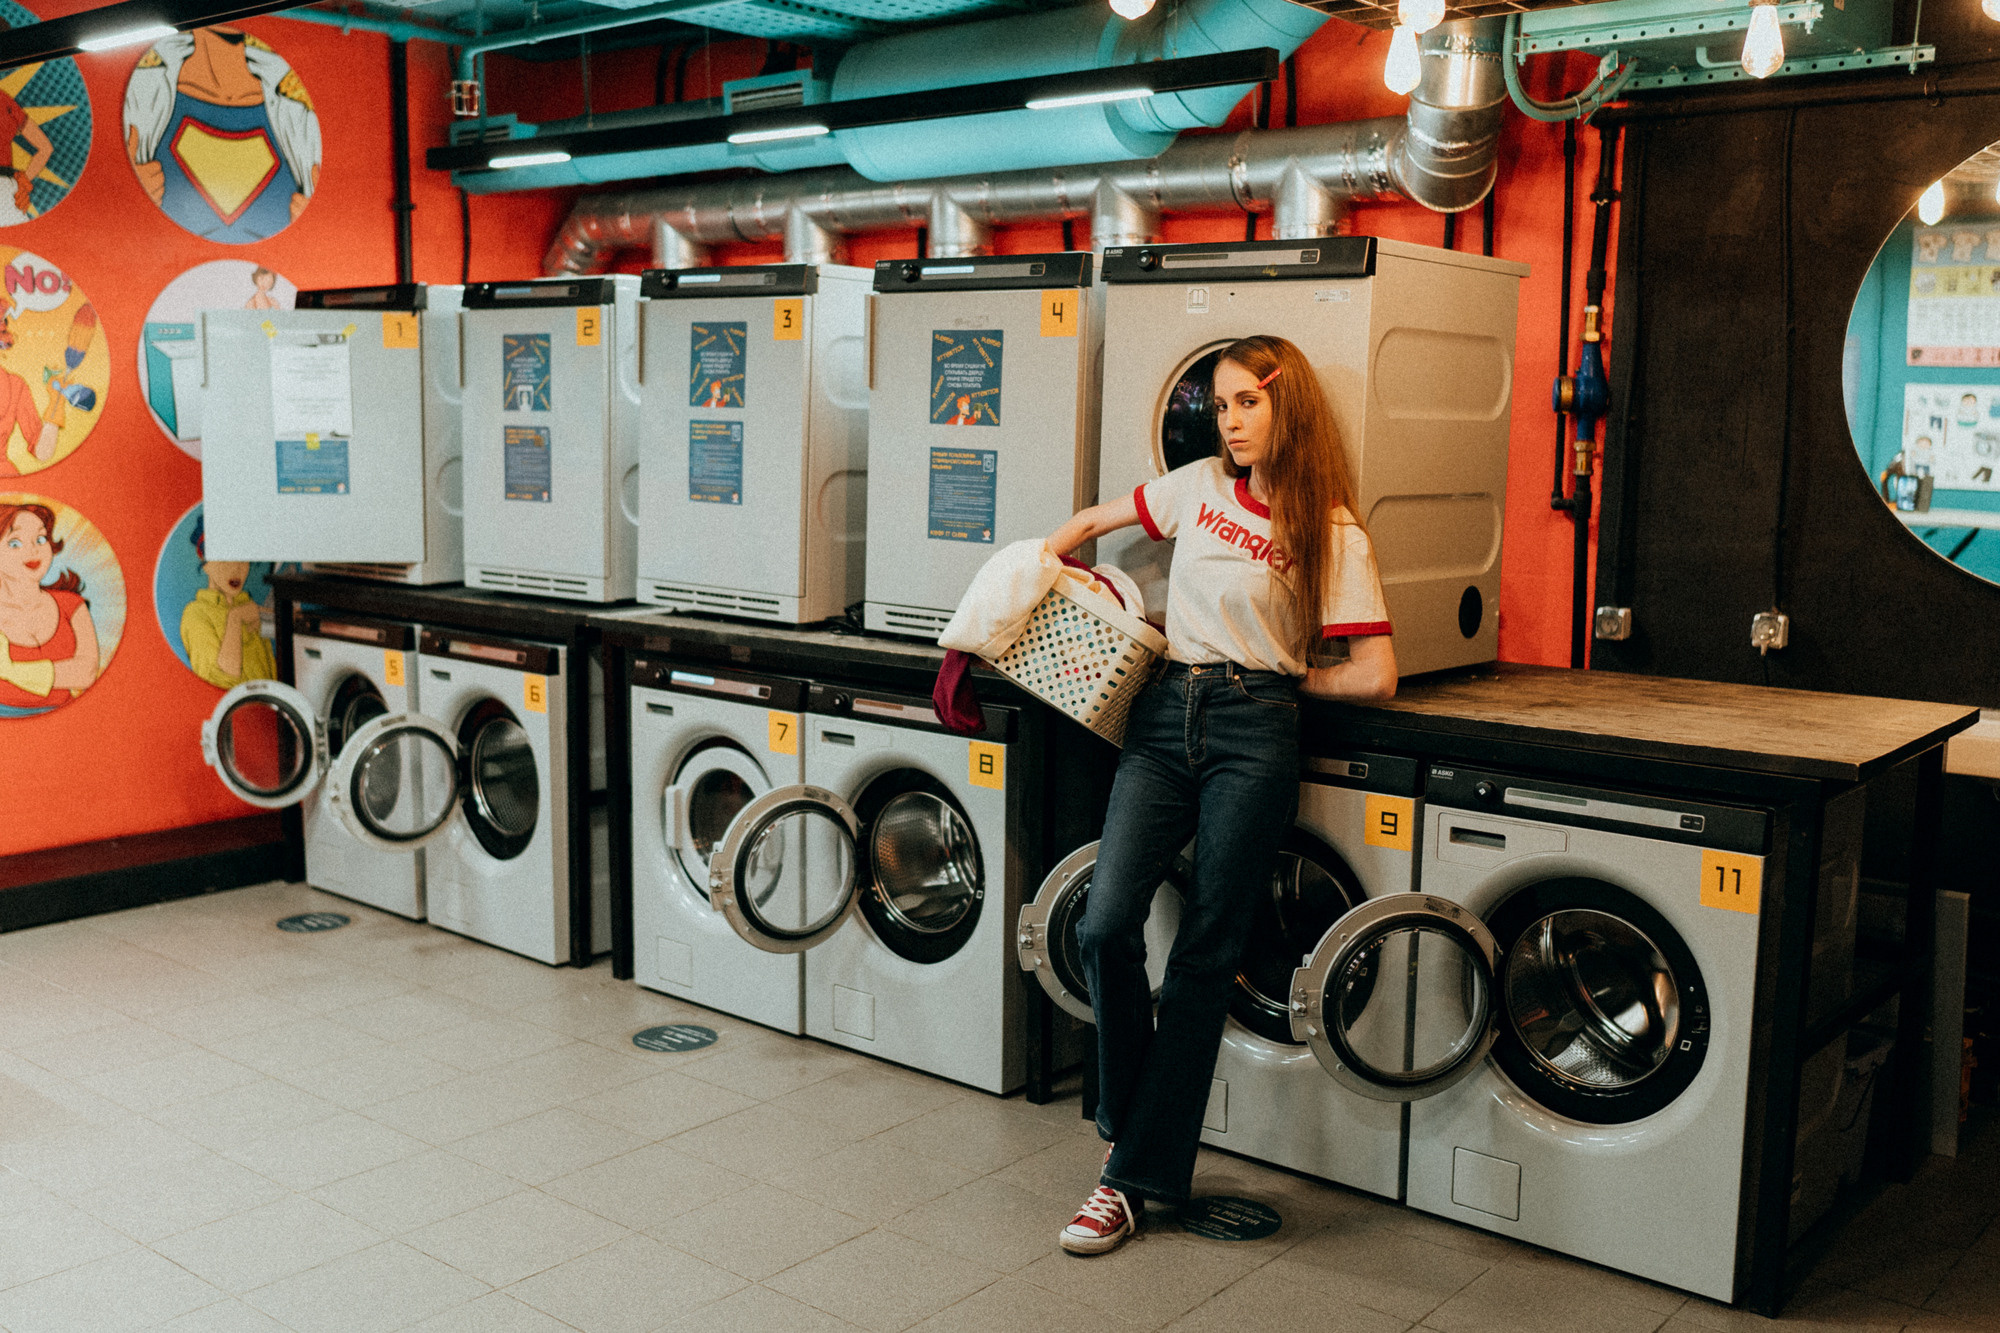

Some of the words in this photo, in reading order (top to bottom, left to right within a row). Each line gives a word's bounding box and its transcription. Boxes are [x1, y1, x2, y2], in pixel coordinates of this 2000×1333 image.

[783, 309, 792, 328] 3
[1051, 302, 1063, 323] 4
[396, 321, 403, 338] 1
[583, 319, 594, 336] 2
[389, 659, 398, 676] 5
[530, 685, 540, 703] 6
[777, 722, 788, 741] 7
[979, 753, 993, 775] 8
[1437, 769, 1454, 777] ASKO
[1381, 811, 1398, 836] 9
[1715, 866, 1741, 895] 11
